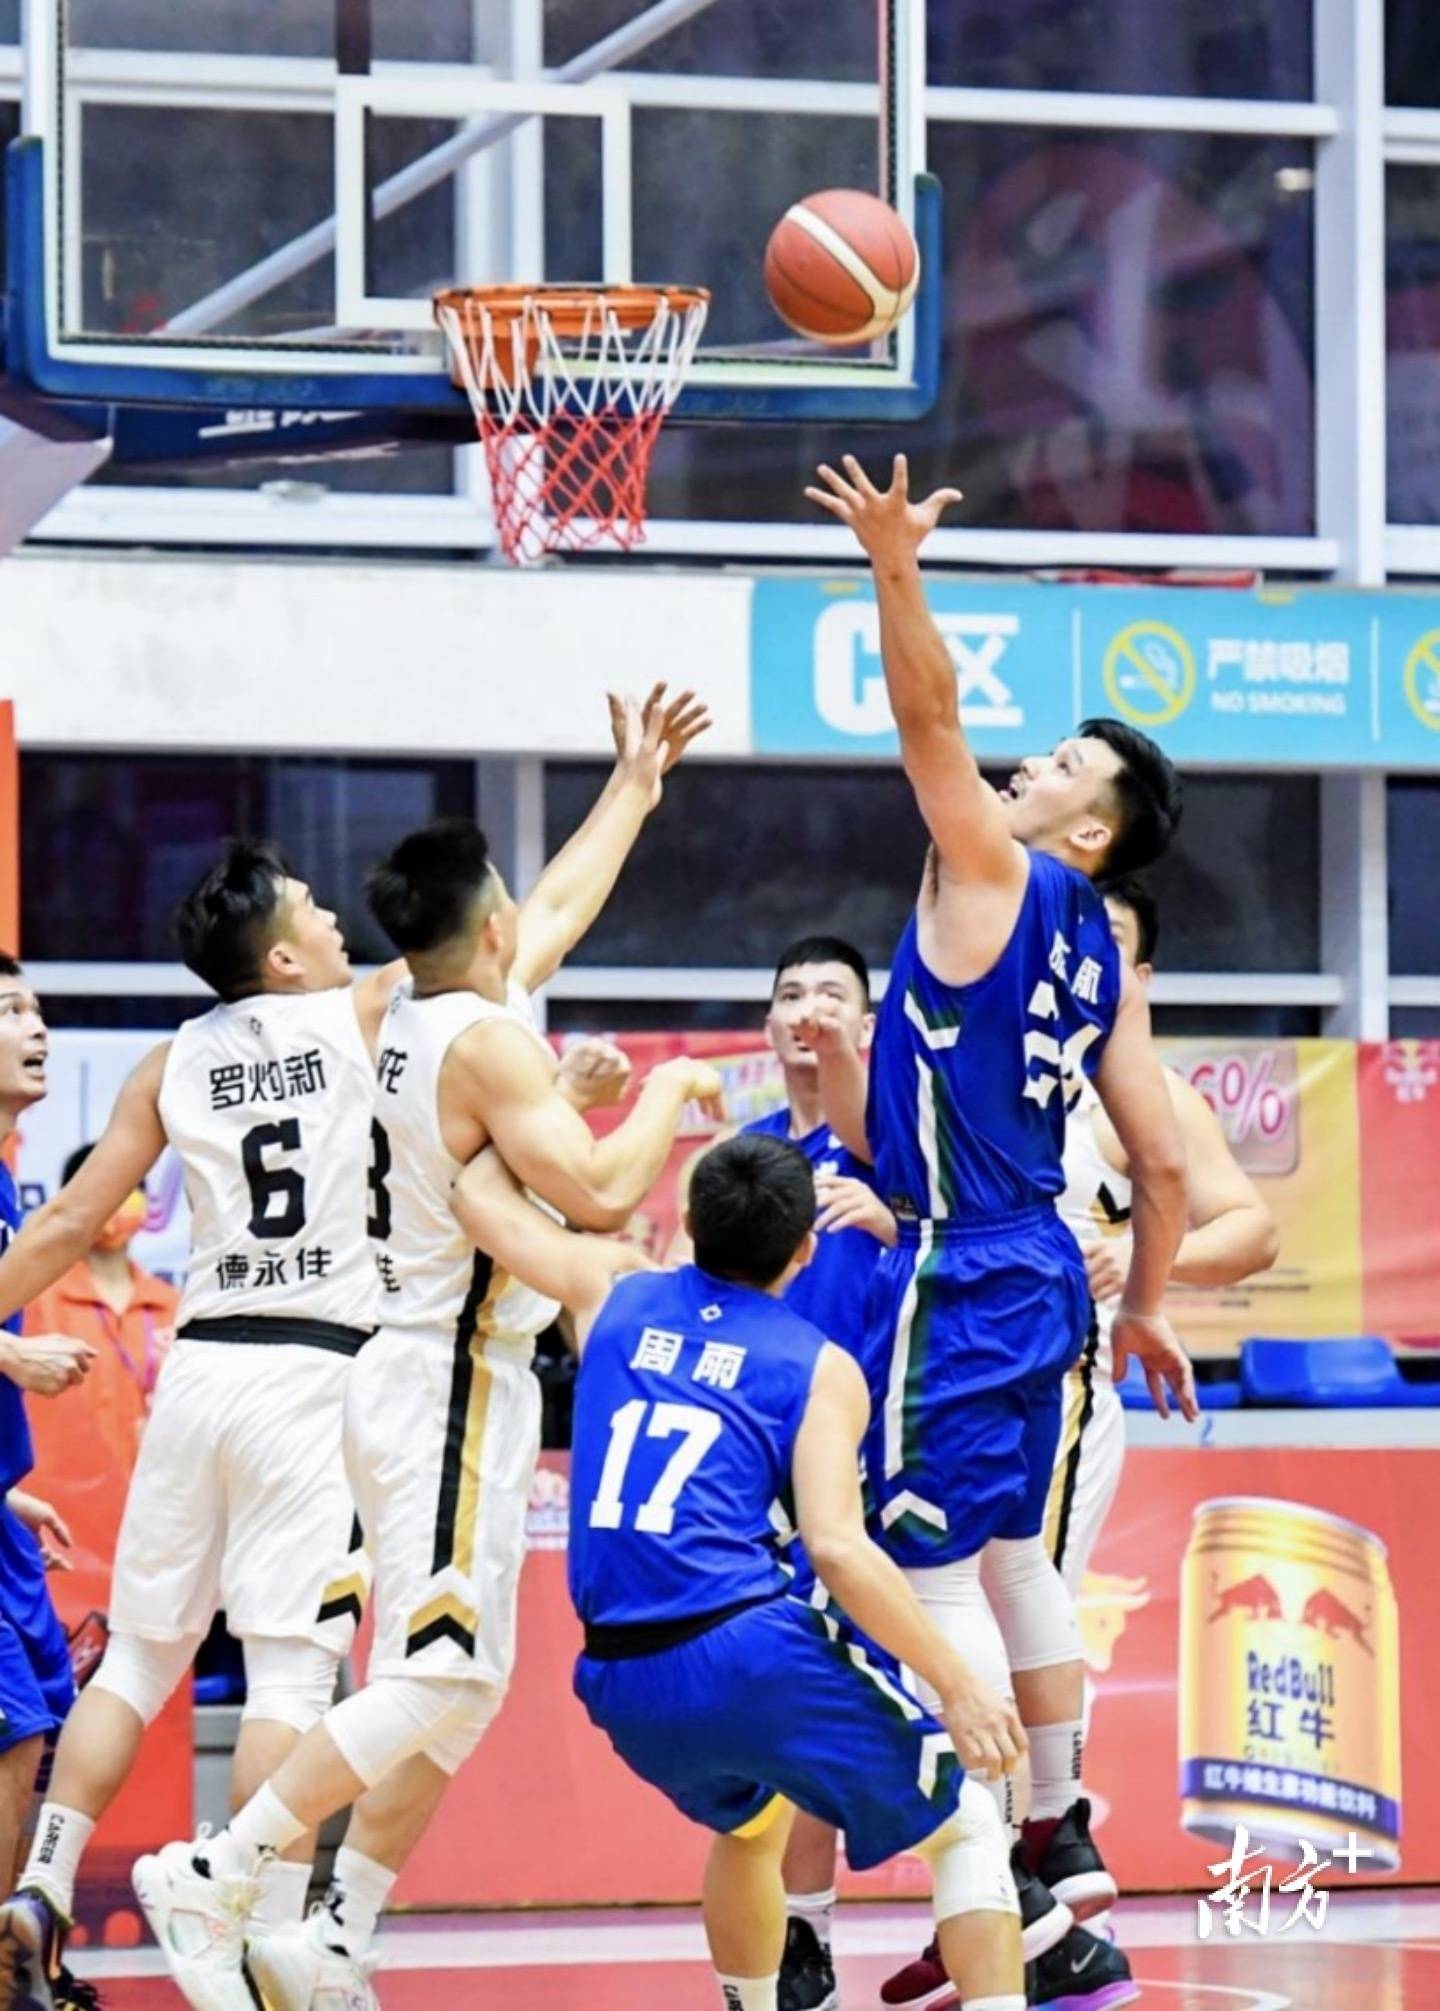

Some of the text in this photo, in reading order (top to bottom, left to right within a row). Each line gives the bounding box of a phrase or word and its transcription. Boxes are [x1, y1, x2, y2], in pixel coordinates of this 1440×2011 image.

[1207, 638, 1350, 683] 严禁吸烟
[1210, 691, 1347, 716] NO SMOKING
[209, 1048, 327, 1111] 罗灼新
[241, 1116, 306, 1240] 6
[215, 1246, 334, 1291] 德永佳
[628, 1326, 747, 1391] 周雨
[588, 1398, 723, 1535] 17
[1247, 1650, 1335, 1707] RedBull
[1247, 1699, 1336, 1750] 红牛
